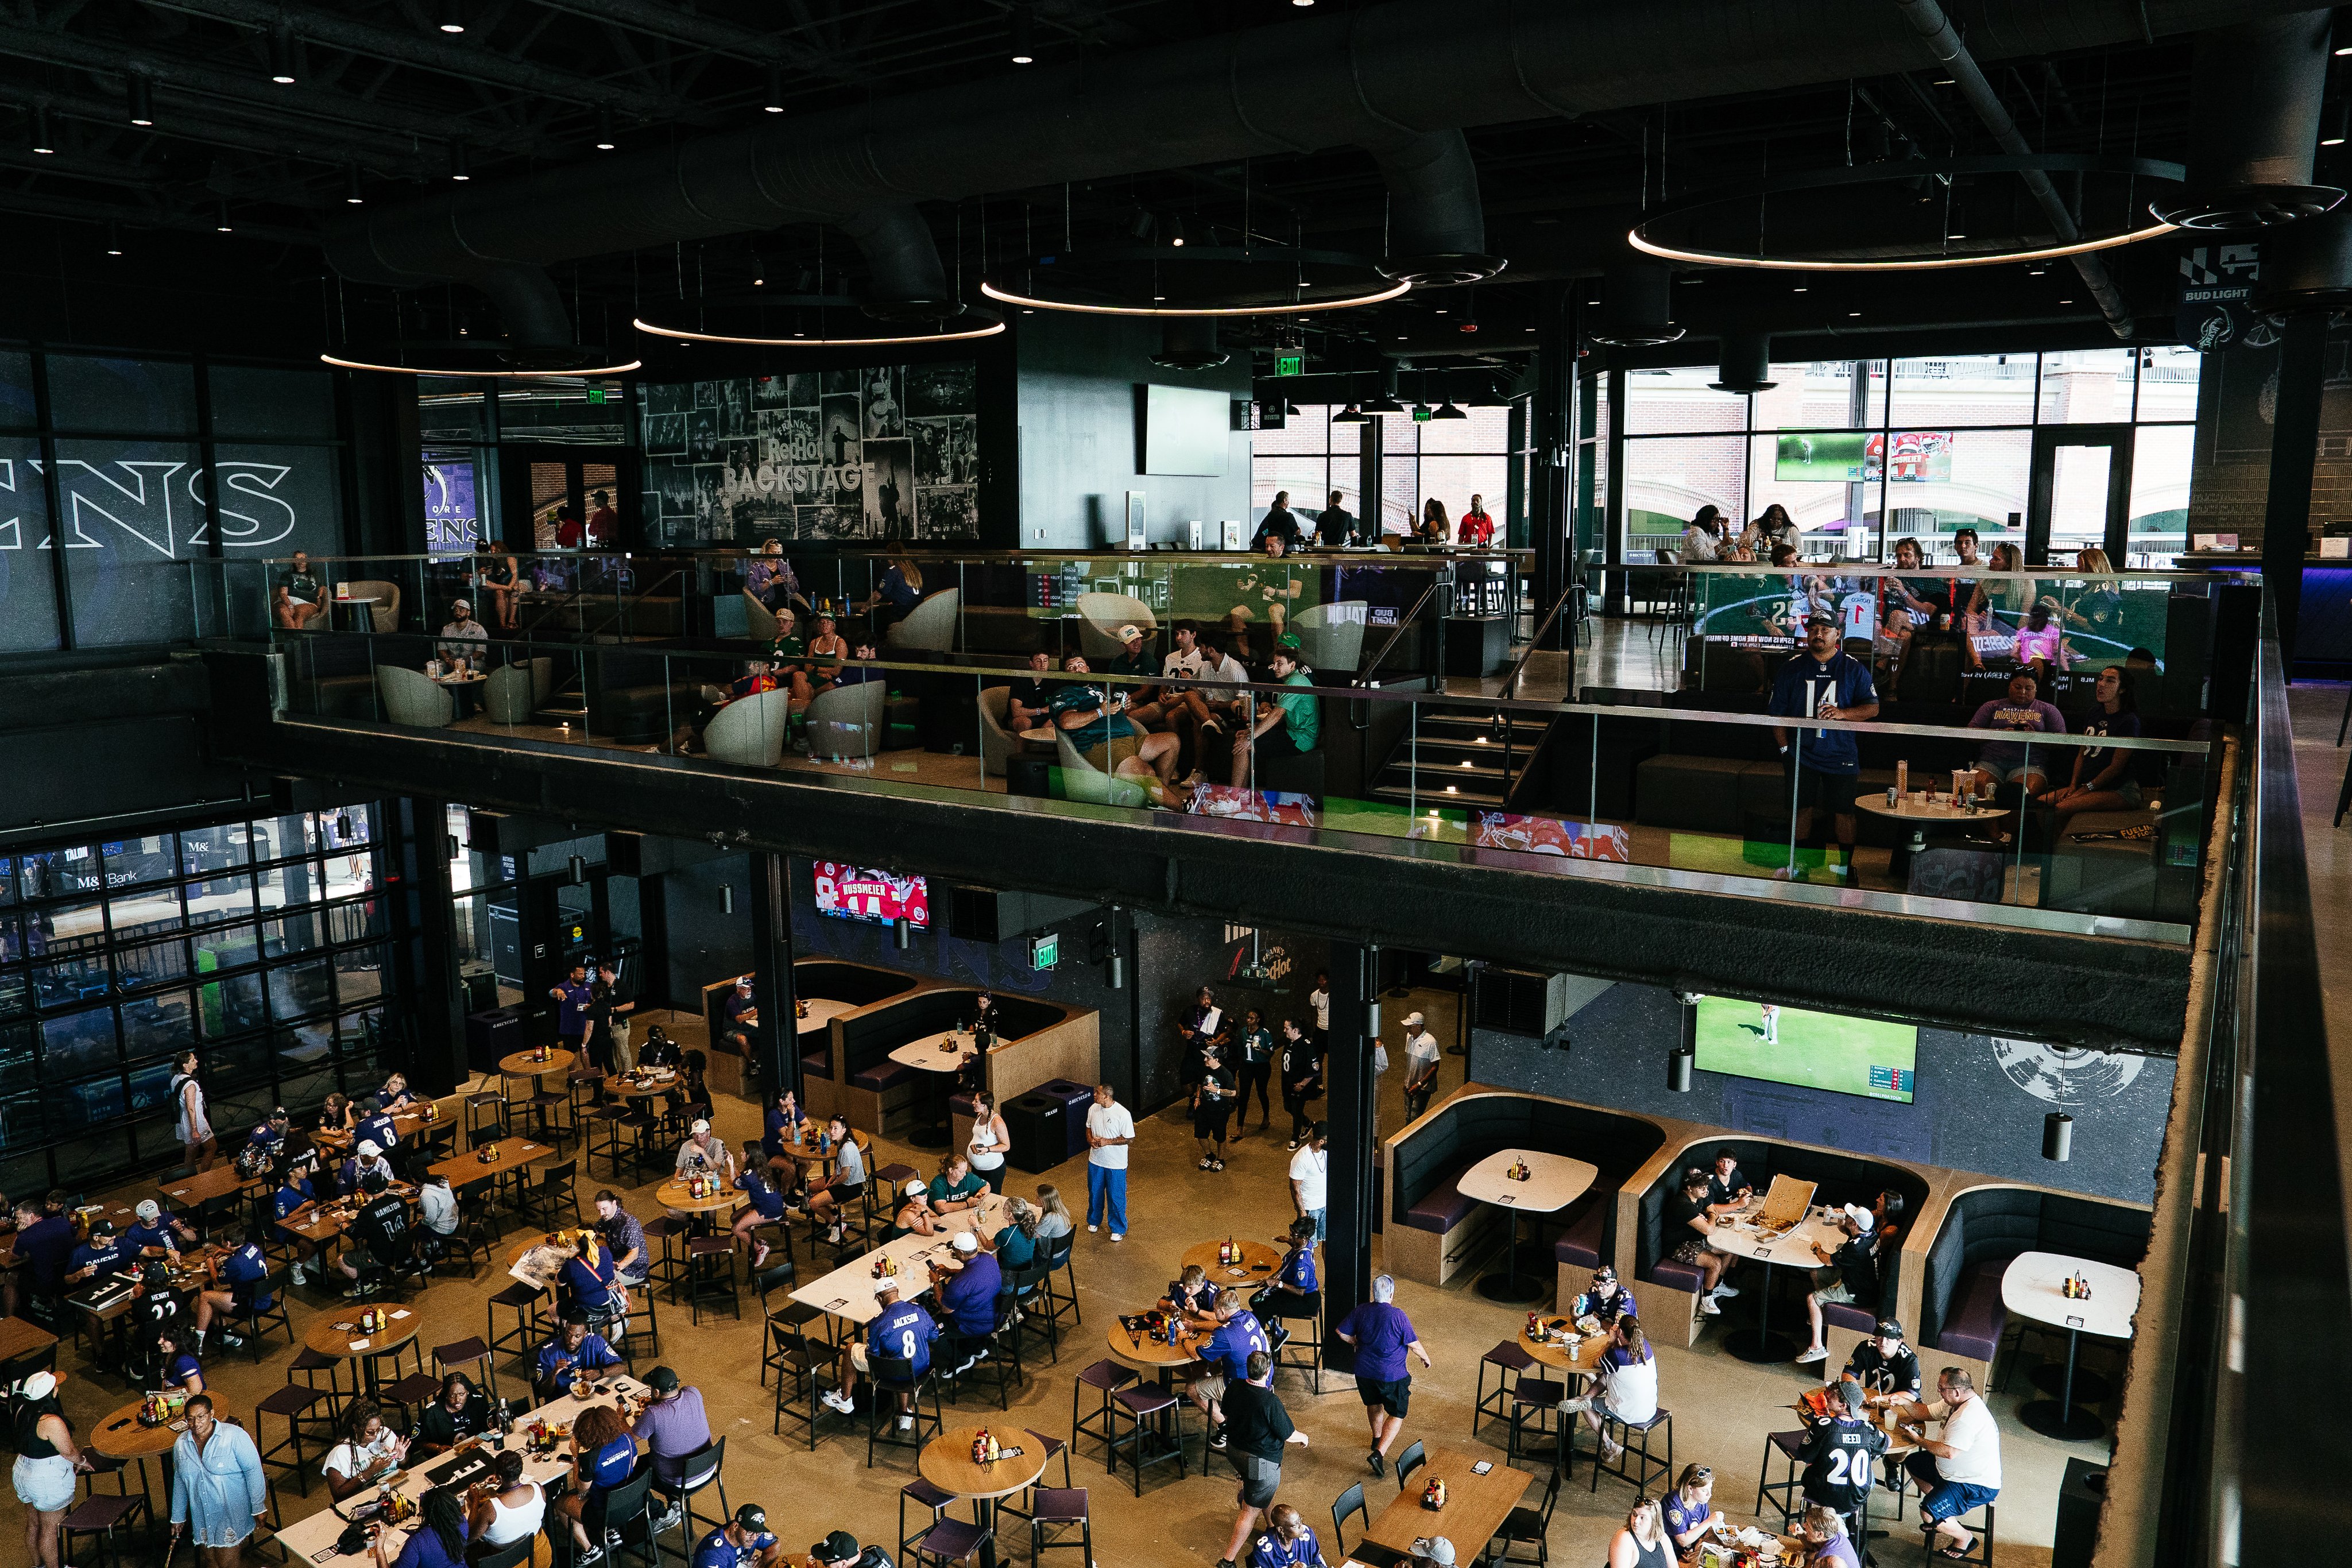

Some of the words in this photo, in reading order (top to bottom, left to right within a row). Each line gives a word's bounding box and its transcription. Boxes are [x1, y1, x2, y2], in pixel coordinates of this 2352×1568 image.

[2185, 291, 2211, 301] BUD
[2212, 289, 2249, 299] LIGHT
[1281, 357, 1300, 375] EXIT
[590, 390, 602, 402] EXIT
[1415, 413, 1429, 423] EXIT
[777, 420, 813, 436] FRANK'S
[767, 434, 824, 462] RedHot
[1891, 454, 1922, 464] USSMEIER
[723, 462, 876, 493] BACKSTAGE
[432, 505, 461, 513] ORE
[425, 518, 478, 544] ENS
[1805, 679, 1838, 719] 14
[1994, 710, 2042, 722] RAVENS
[64, 846, 88, 861] TALON
[188, 842, 209, 852] M&
[108, 870, 137, 885] Bank
[842, 883, 887, 896] NUSSMEIER
[1038, 944, 1054, 968] EXIT
[496, 1019, 516, 1027] RECYCLE
[1283, 1052, 1290, 1072] 8
[1071, 1093, 1088, 1103] RECYCLE
[1045, 1108, 1058, 1117] TRASH
[373, 1116, 392, 1128] JACKSON
[383, 1127, 396, 1147] 8
[374, 1201, 401, 1218] HAMILTON
[382, 1214, 405, 1241] 14
[151, 1291, 169, 1301] HENRY
[892, 1312, 920, 1329] JACKSON
[902, 1329, 916, 1359] 8
[1897, 1342, 1912, 1360] 22
[1842, 1434, 1862, 1445] REED
[601, 1449, 629, 1467] RAVENS
[1826, 1449, 1870, 1487] 20
